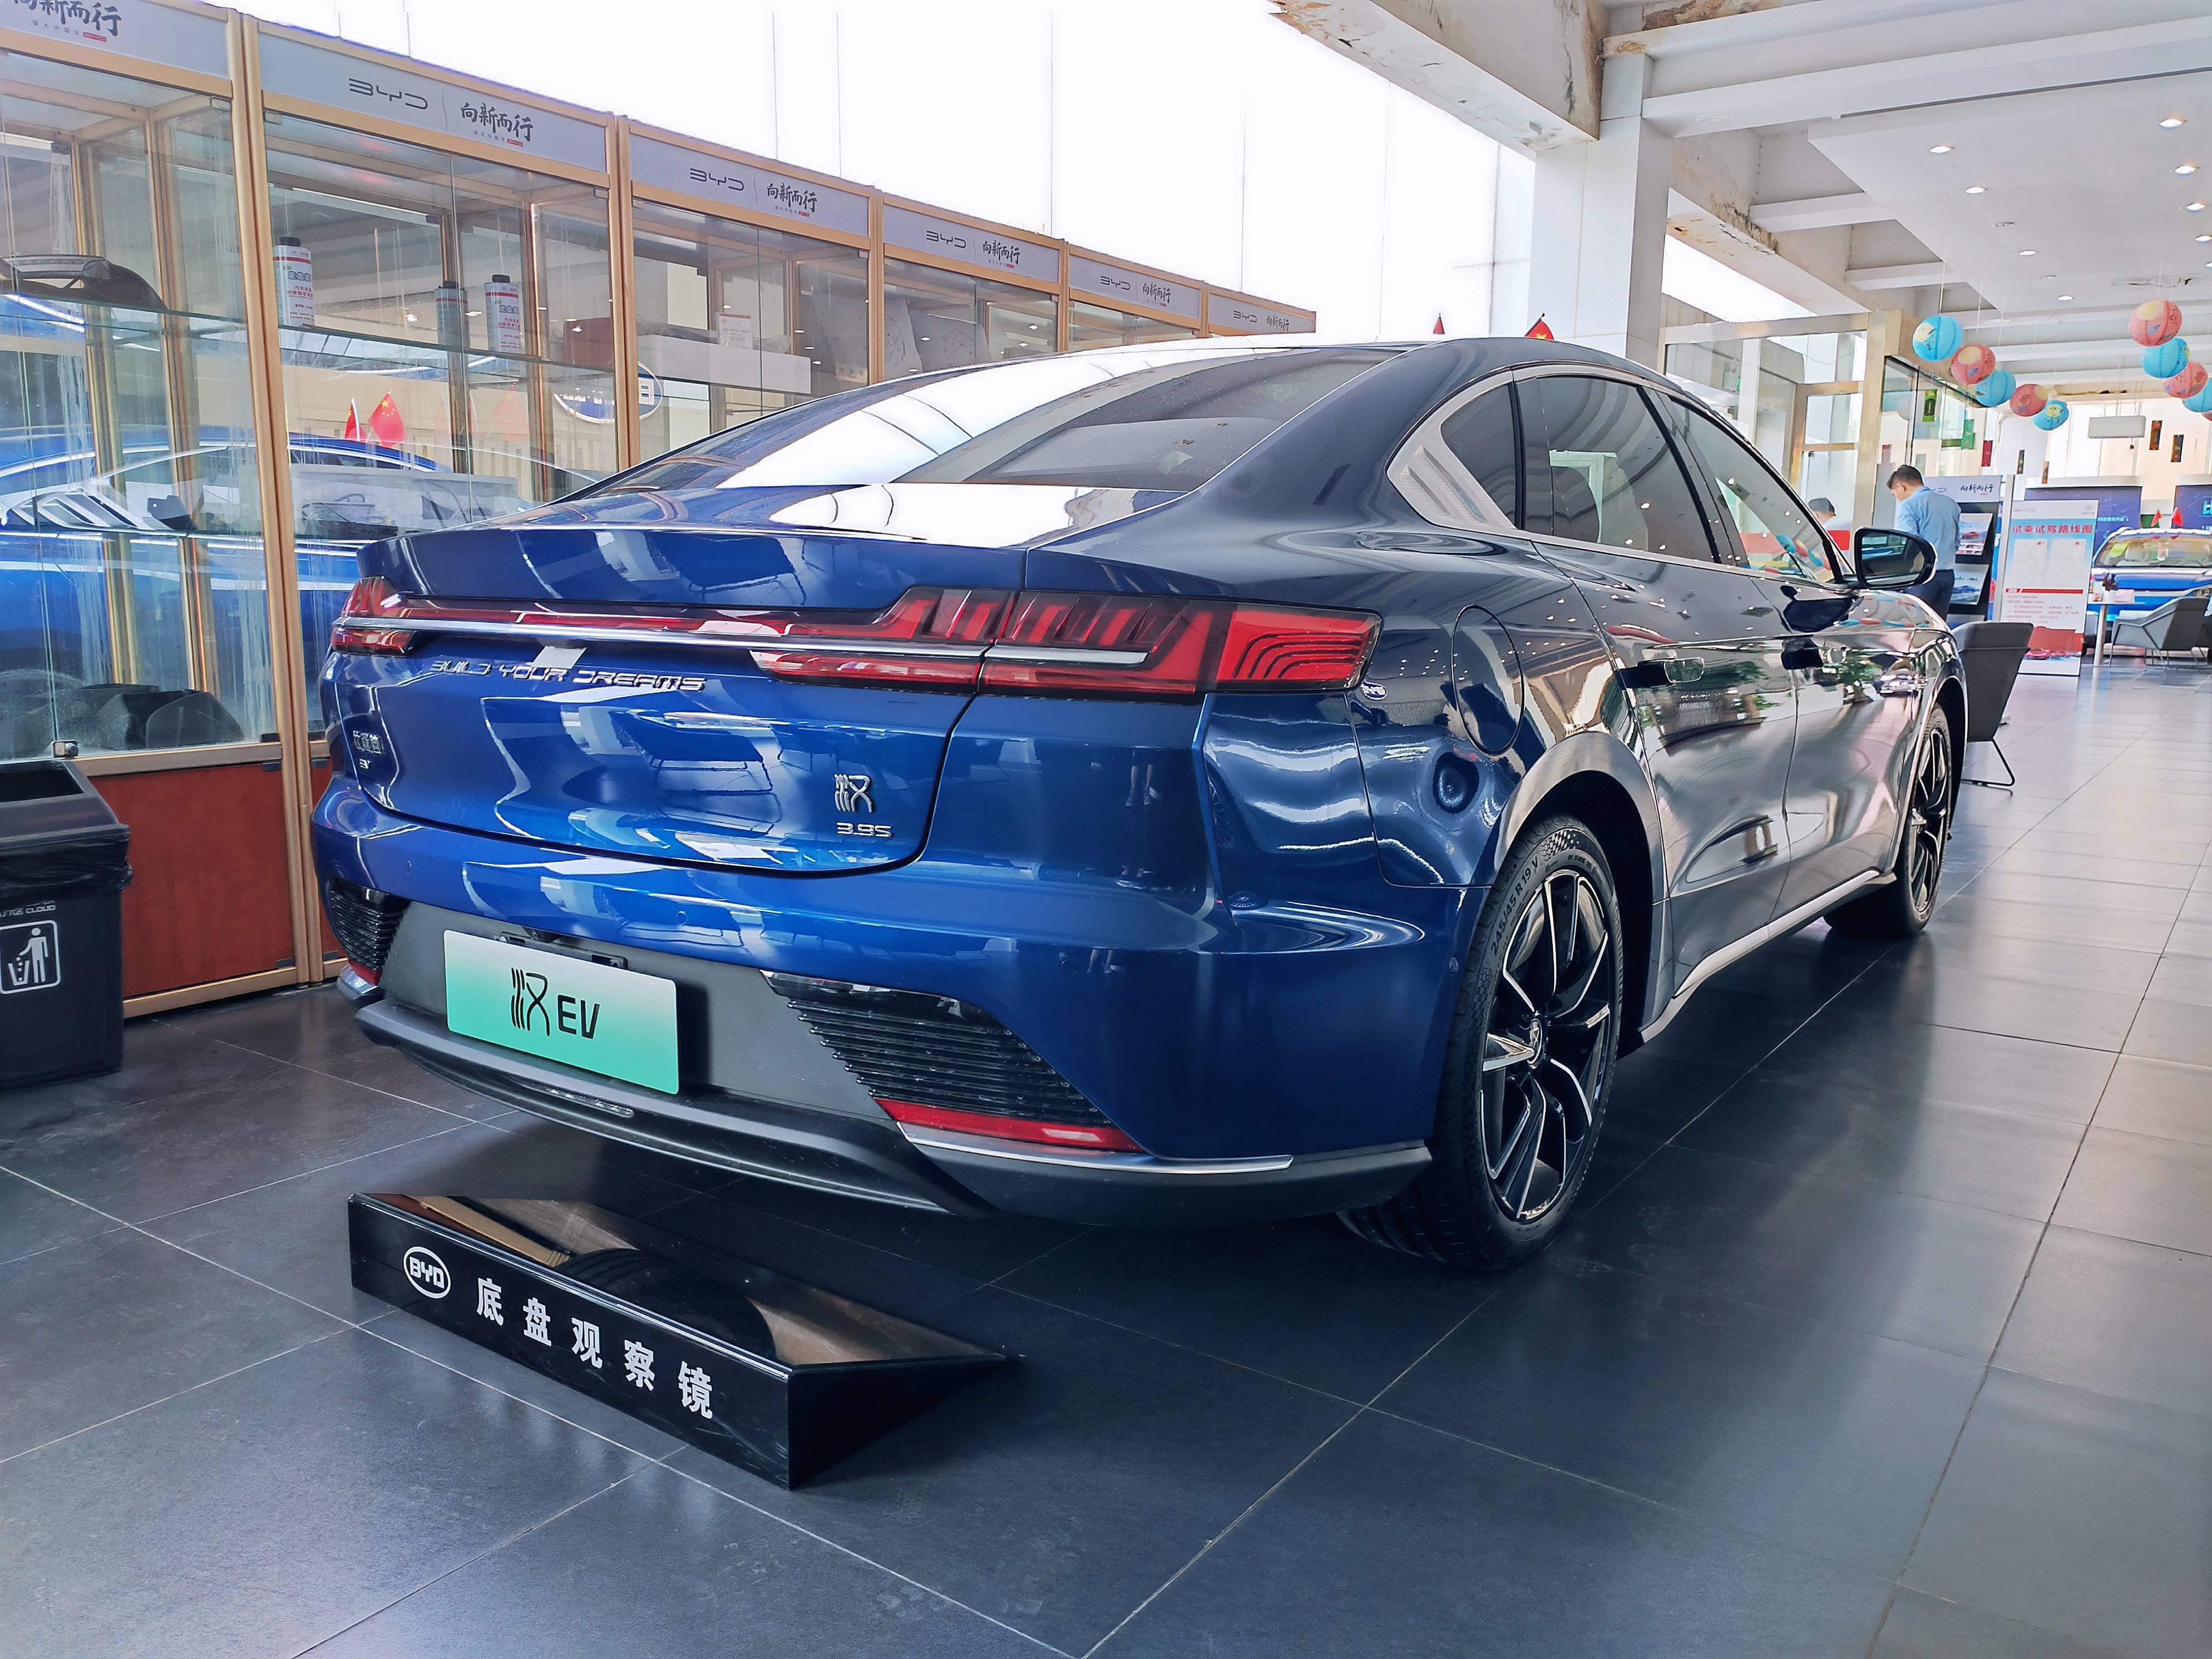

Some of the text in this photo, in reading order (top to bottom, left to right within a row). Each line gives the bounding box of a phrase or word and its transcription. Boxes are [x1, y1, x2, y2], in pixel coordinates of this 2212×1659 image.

[349, 78, 534, 142] BYD 向新而行
[690, 168, 817, 213] BYD 向新而行
[926, 230, 1020, 264] BYD 向新而行
[1101, 275, 1171, 303] BYD 向新而行
[1233, 311, 1290, 331] BYD 向新而行
[431, 660, 707, 692] BUILD YOUR DREAMS
[1515, 883, 1523, 894] R
[1521, 867, 1532, 884] 19
[26, 905, 56, 914] CLOUD
[557, 994, 600, 1040] EV
[409, 1256, 713, 1420] BYD 底盘观察镜
